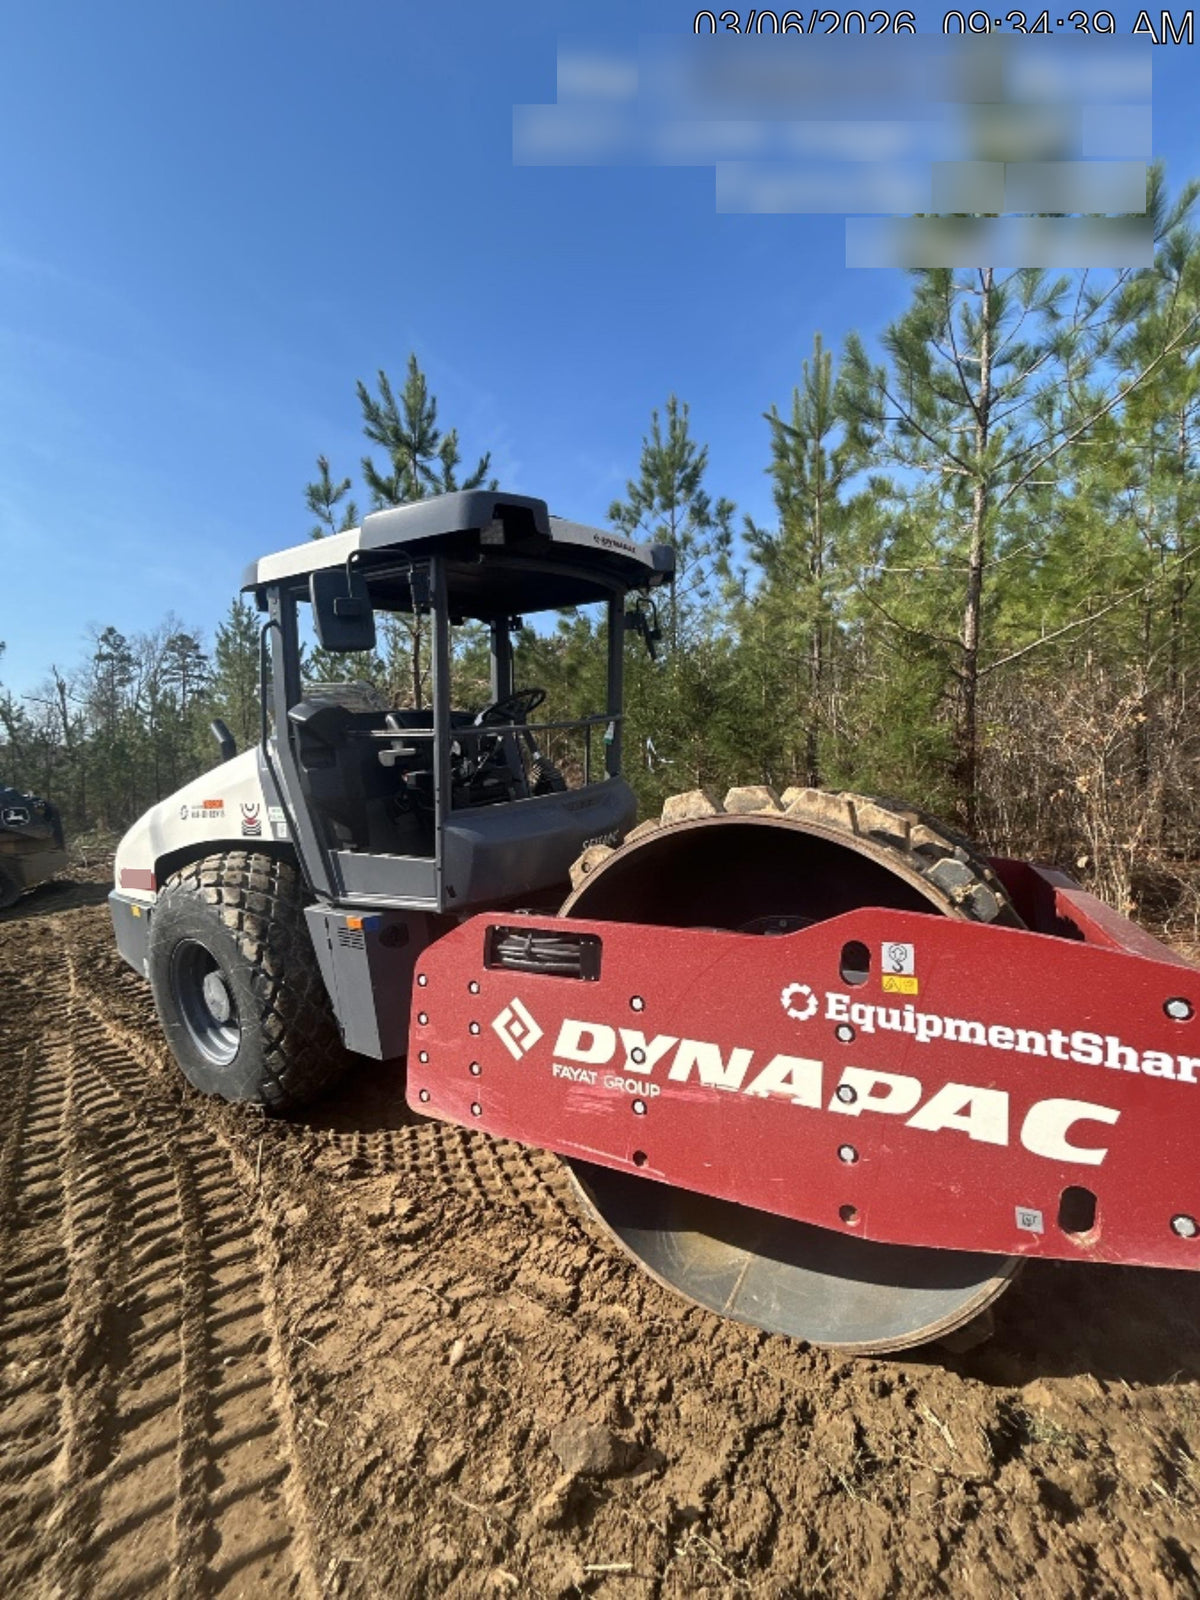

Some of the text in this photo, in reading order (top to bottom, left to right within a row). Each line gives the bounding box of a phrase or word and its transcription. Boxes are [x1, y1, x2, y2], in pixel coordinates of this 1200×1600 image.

[552, 1063, 660, 1098] FAYAT GROUP
[552, 1018, 1121, 1165] DYNAPAC
